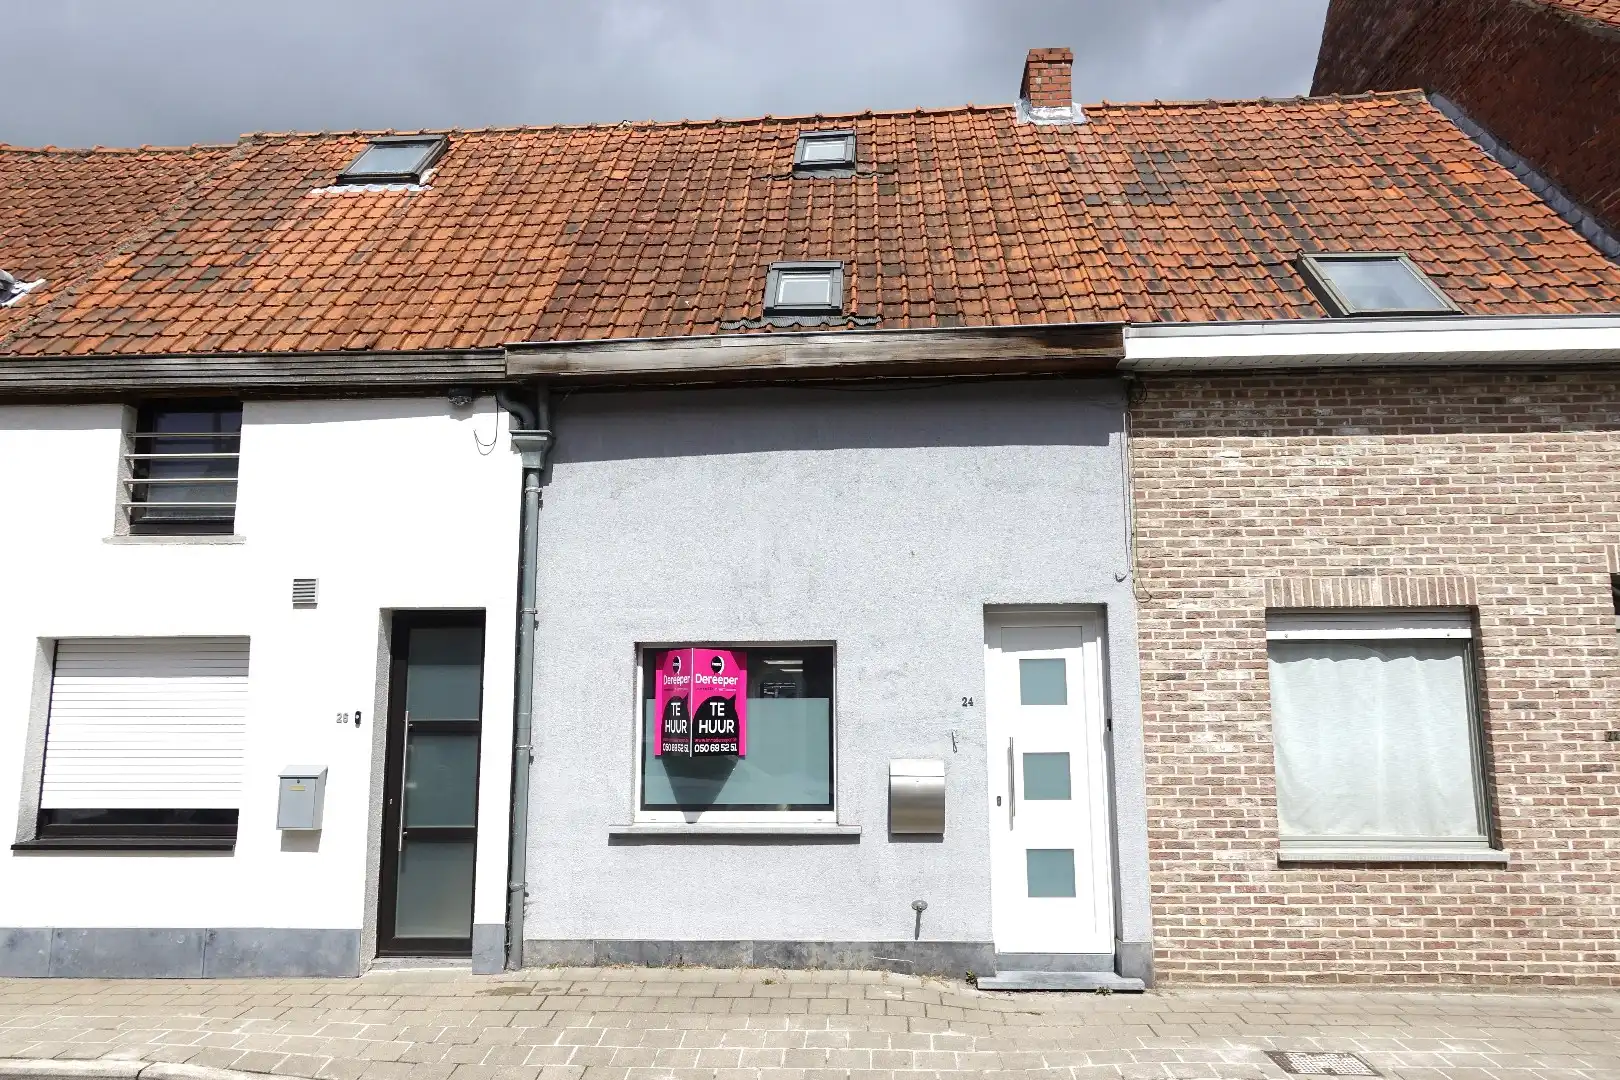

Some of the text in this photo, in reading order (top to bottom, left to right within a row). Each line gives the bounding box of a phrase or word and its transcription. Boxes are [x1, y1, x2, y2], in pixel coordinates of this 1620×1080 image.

[695, 673, 738, 687] Dereeper
[961, 696, 974, 707] 24
[670, 702, 681, 716] TE
[709, 702, 725, 717] TE
[664, 719, 688, 733] HUUR
[698, 719, 735, 734] HUUR
[694, 744, 710, 753] 050
[720, 743, 730, 752] 52
[730, 743, 738, 752] 51
